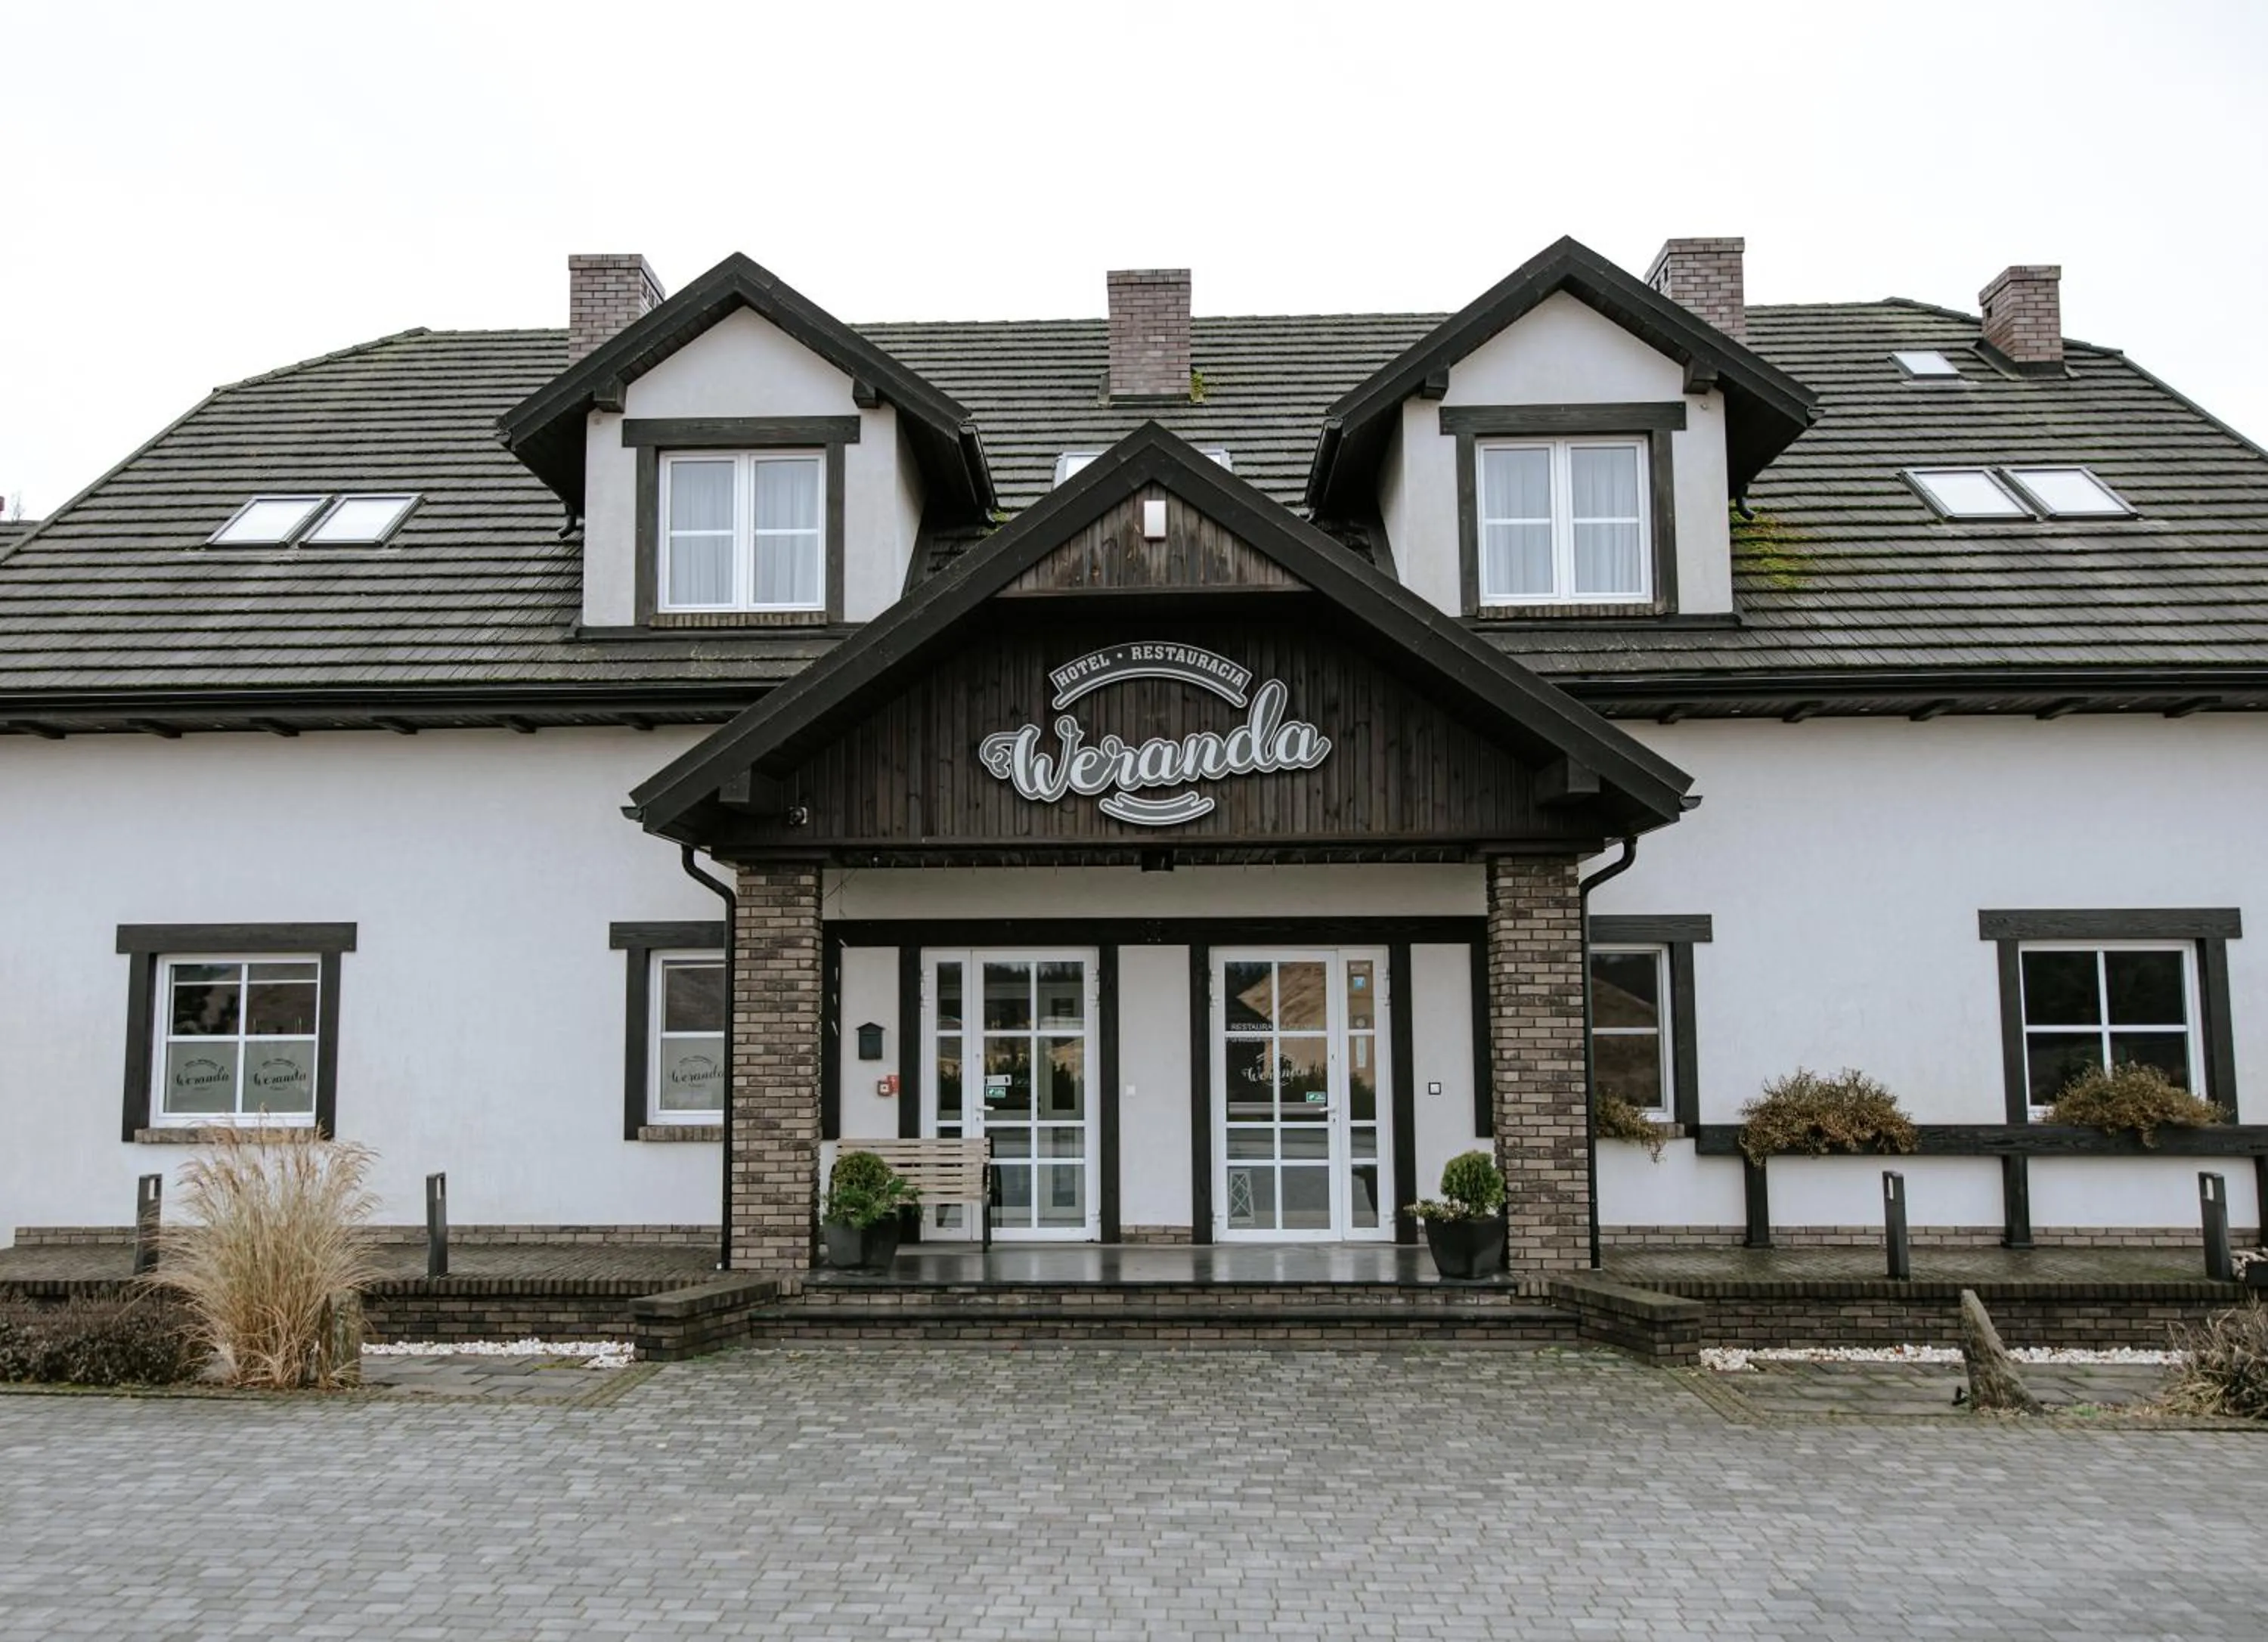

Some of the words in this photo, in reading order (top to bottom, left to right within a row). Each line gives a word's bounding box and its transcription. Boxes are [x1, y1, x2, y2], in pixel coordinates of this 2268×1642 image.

[1055, 653, 1111, 687] HOTEL
[1130, 646, 1245, 686] RESTAURACJA
[980, 679, 1331, 802] Weranda
